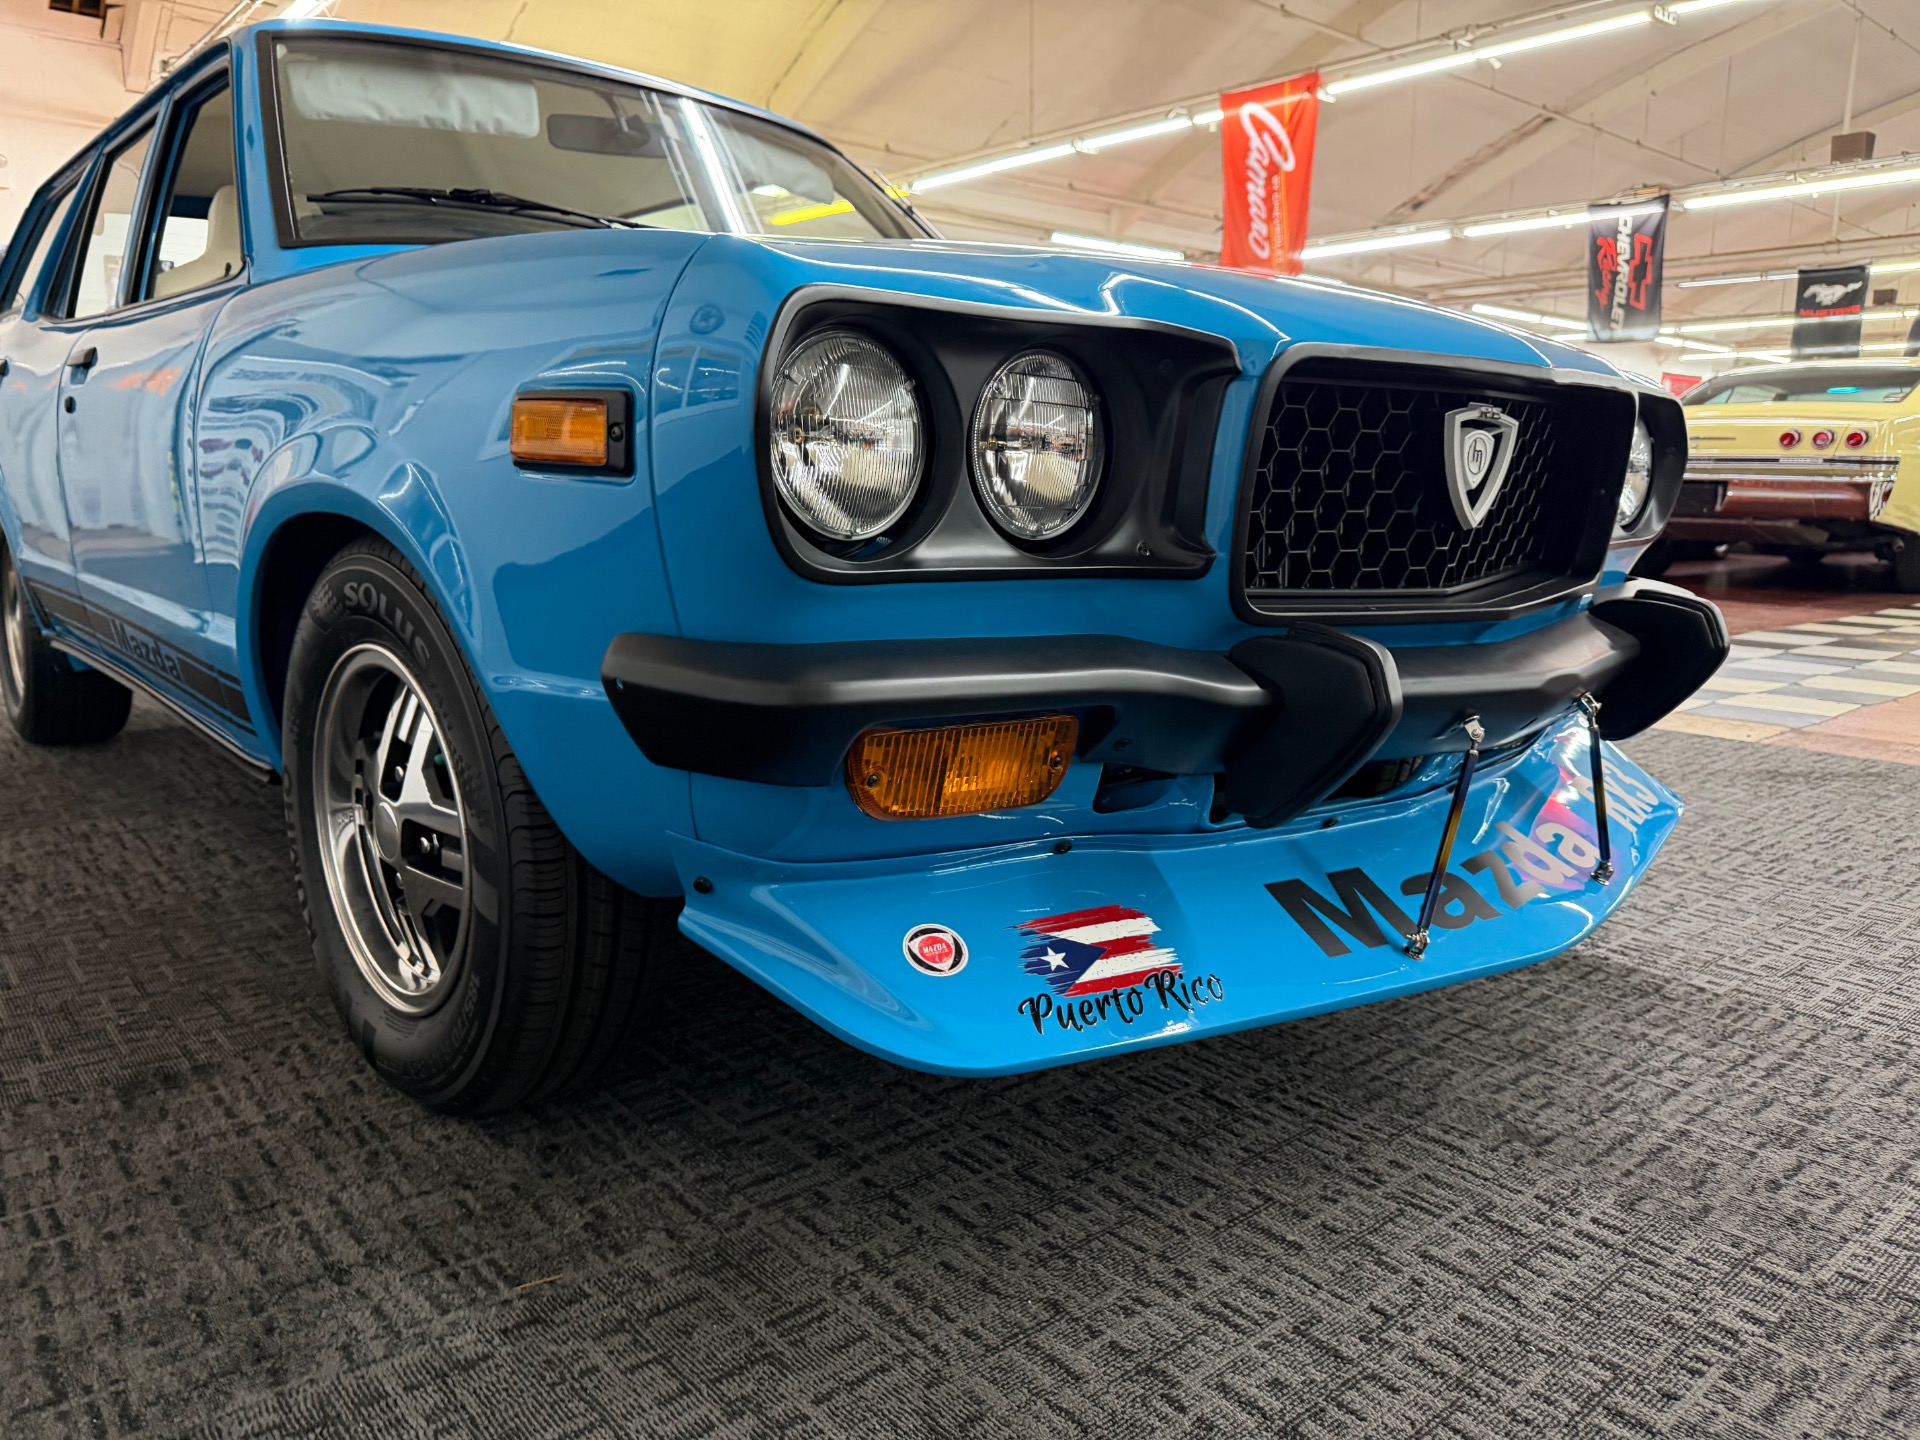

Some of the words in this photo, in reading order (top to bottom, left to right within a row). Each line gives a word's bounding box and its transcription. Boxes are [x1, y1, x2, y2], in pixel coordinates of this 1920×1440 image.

[1240, 102, 1297, 260] Camaro
[1595, 236, 1617, 312] Racing
[1609, 216, 1634, 332] CHEVROLET
[1799, 304, 1861, 318] MUSTANG
[110, 618, 183, 682] Mazda
[343, 580, 431, 670] SOLUS
[1264, 821, 1603, 958] Mazda
[922, 942, 948, 954] MAZDA
[451, 971, 482, 1048] 185/70
[1017, 986, 1145, 1035] Puerto
[1143, 969, 1225, 1013] Rico
